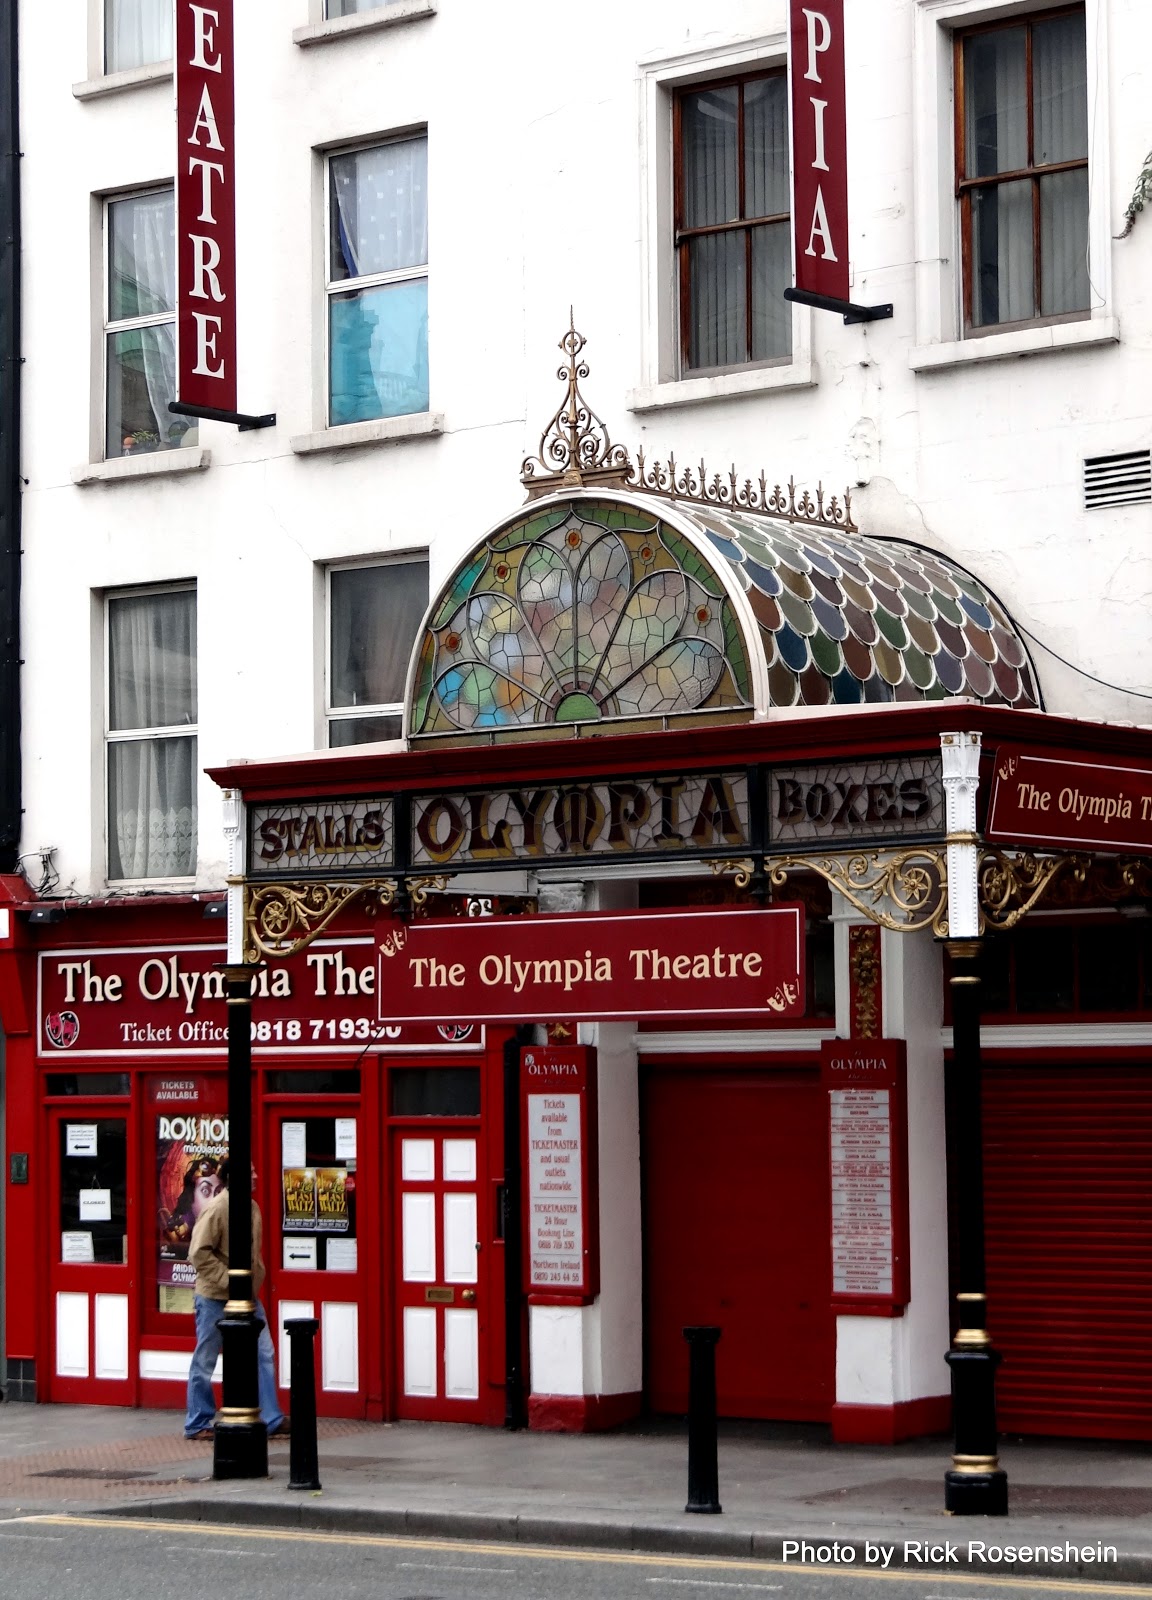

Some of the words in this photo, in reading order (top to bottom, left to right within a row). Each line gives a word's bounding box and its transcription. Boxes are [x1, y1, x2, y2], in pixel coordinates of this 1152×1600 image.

[777, 778, 933, 828] BOXES
[1017, 783, 1051, 811] The
[1058, 787, 1133, 824] Olympia
[1140, 796, 1152, 820] T
[416, 777, 747, 863] OLYMPIA
[260, 809, 385, 863] STALLS
[408, 957, 466, 988] The
[478, 950, 613, 994] Olympia
[629, 946, 763, 980] Theatre
[58, 960, 122, 1003] The
[120, 1022, 172, 1042] Ticket
[178, 1021, 230, 1041] Office
[528, 1064, 578, 1075] OLYMPIA
[831, 1058, 887, 1070] OLYMPIA
[161, 1081, 194, 1089] TICKETS
[156, 1091, 199, 1099] AVAILABLE
[543, 1099, 565, 1109] Tickets
[541, 1113, 568, 1122] available
[159, 1116, 197, 1141] ROSS
[547, 1126, 562, 1136] from
[532, 1140, 579, 1150] TICKETMASTER
[545, 1167, 566, 1177] outlets
[539, 1181, 572, 1191] nationwide
[534, 1204, 578, 1213] TICKETMASTER
[537, 1228, 561, 1239] Booking
